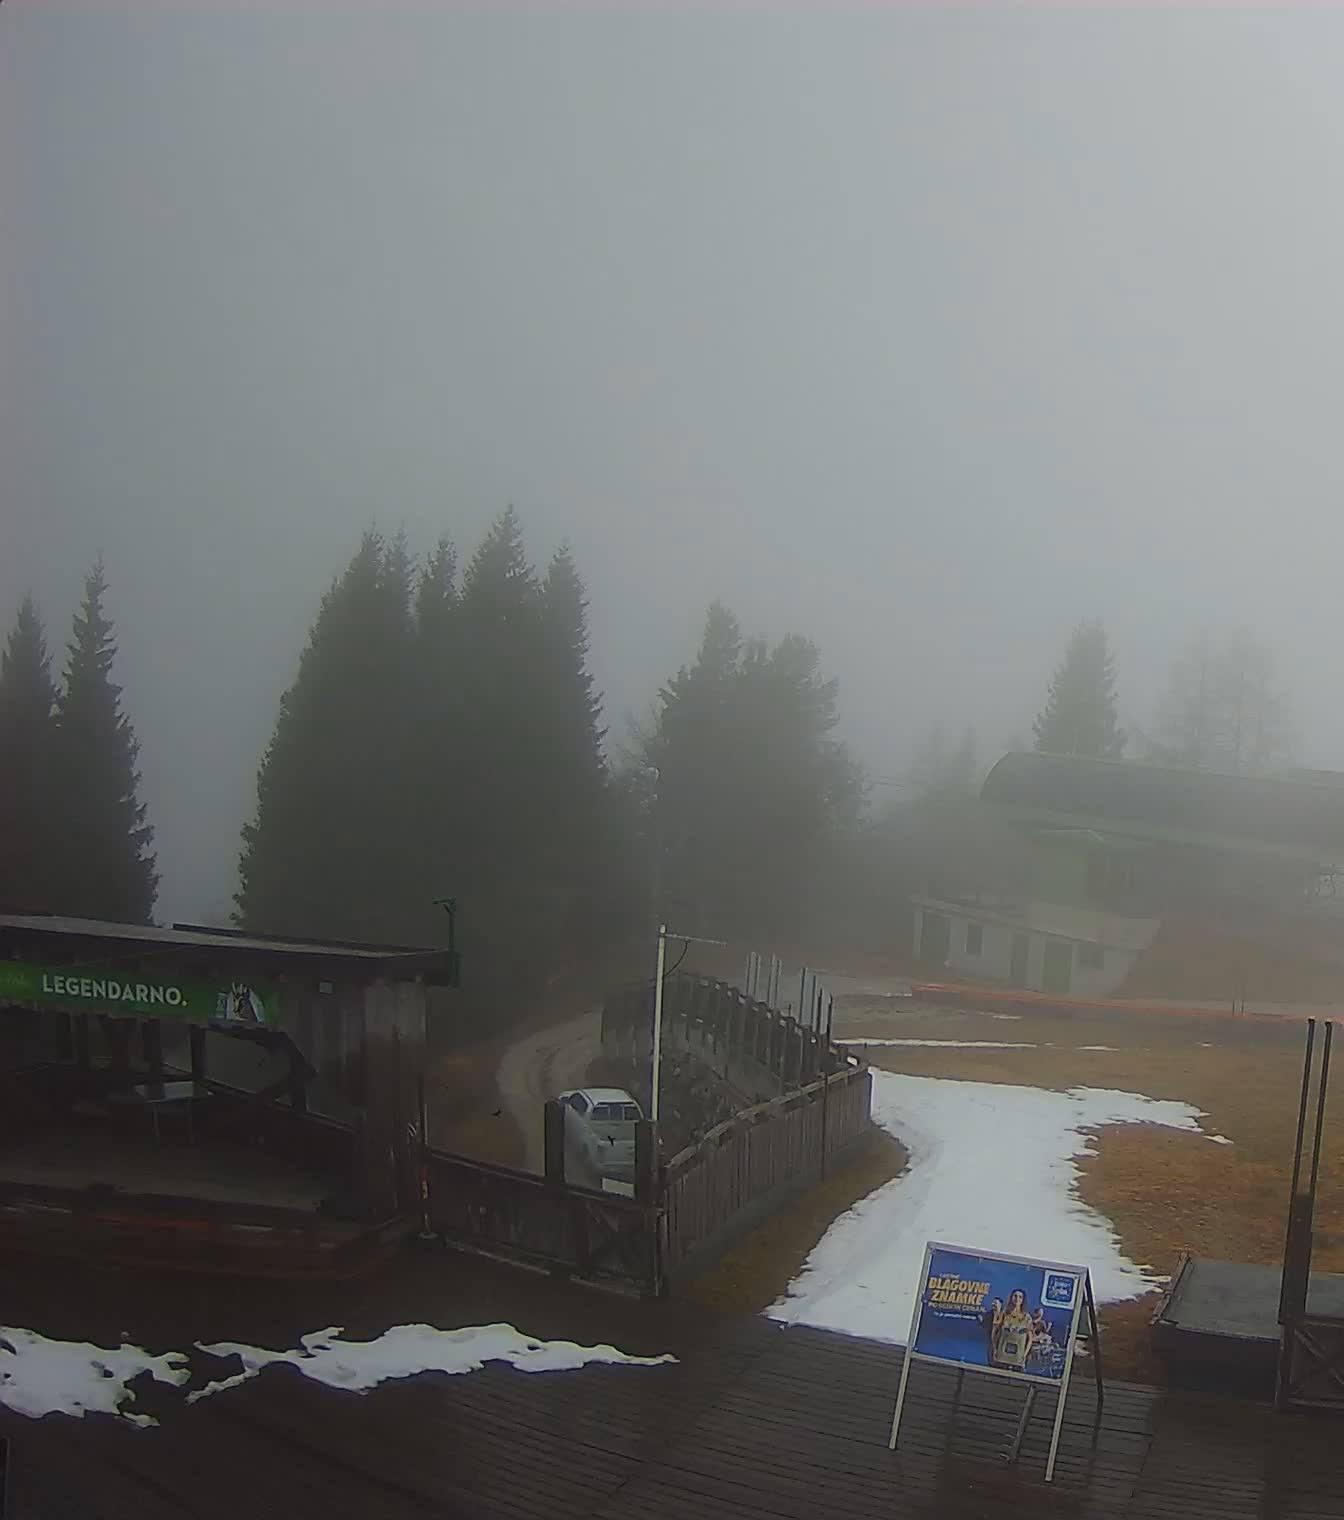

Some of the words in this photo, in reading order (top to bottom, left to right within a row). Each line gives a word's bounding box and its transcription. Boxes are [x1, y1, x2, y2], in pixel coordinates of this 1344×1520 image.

[41, 974, 188, 1007] LEGENDARNO.
[928, 1276, 991, 1295] BLAGOVNE
[930, 1290, 985, 1305] ZNAMKE
